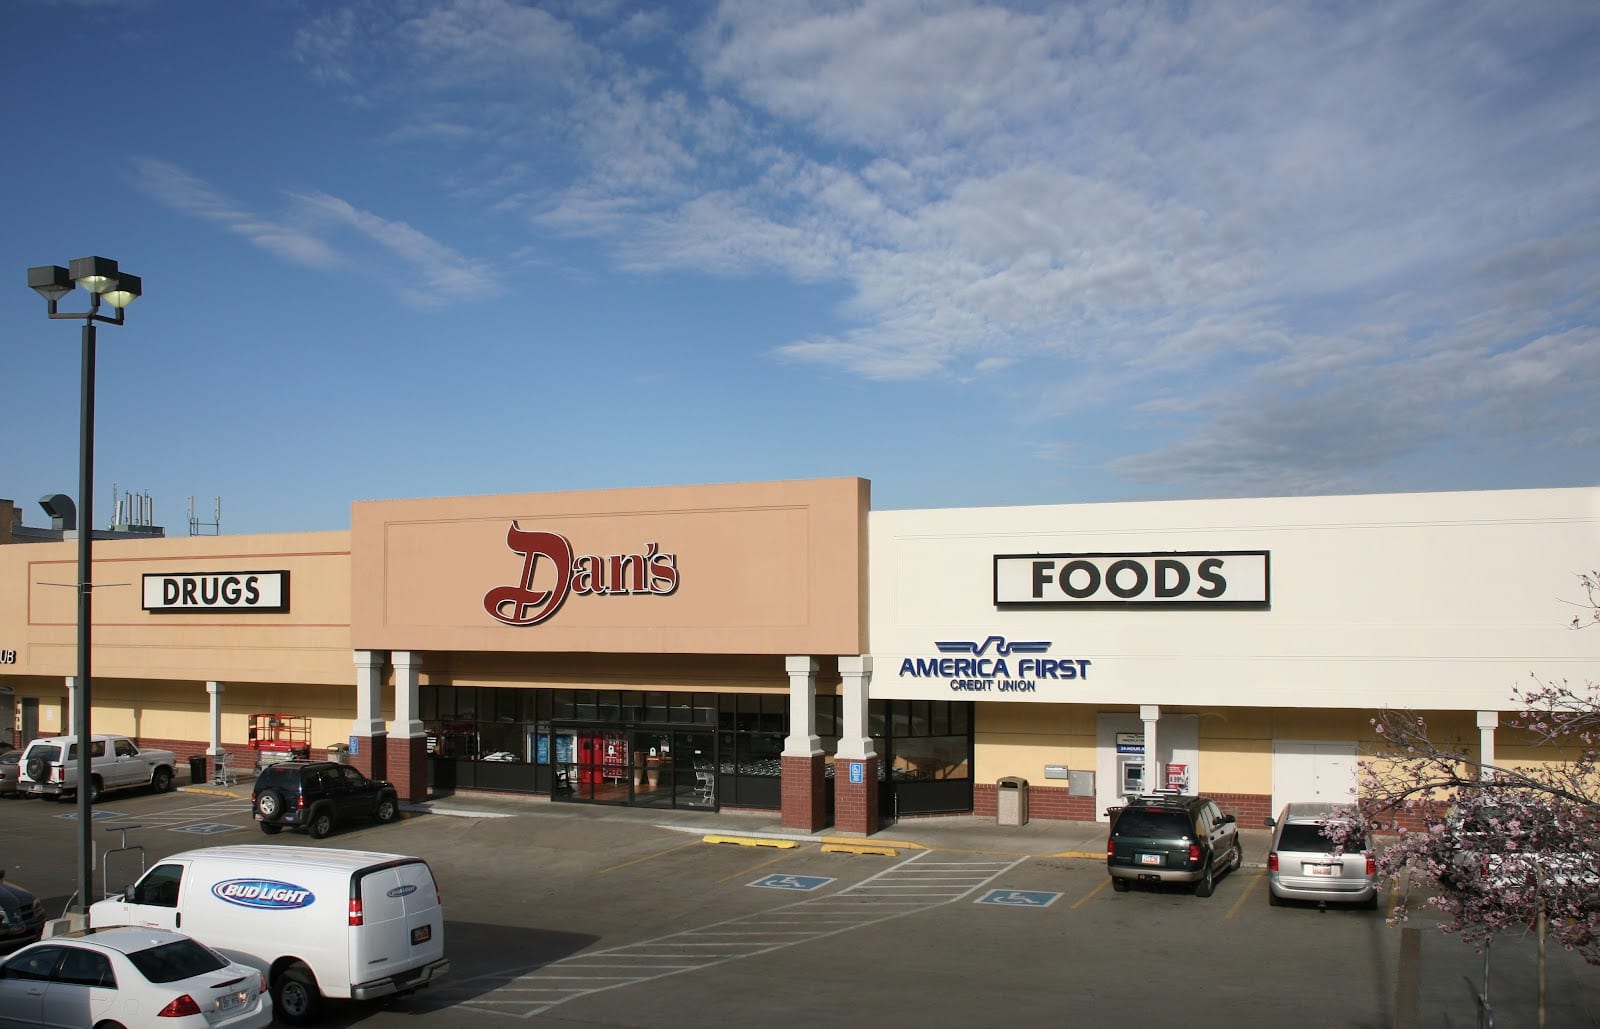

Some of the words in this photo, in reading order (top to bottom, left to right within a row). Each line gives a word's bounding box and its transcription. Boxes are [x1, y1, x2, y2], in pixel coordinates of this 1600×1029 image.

[484, 520, 680, 627] Dan's
[1032, 558, 1227, 599] FOODS
[163, 576, 260, 605] DRUGS
[899, 658, 1010, 678] AMERICA
[1018, 659, 1092, 680] FIRST
[950, 679, 994, 692] CREDIT
[997, 680, 1036, 692] UNION
[224, 884, 259, 898] BUD
[259, 888, 309, 903] LIGHT
